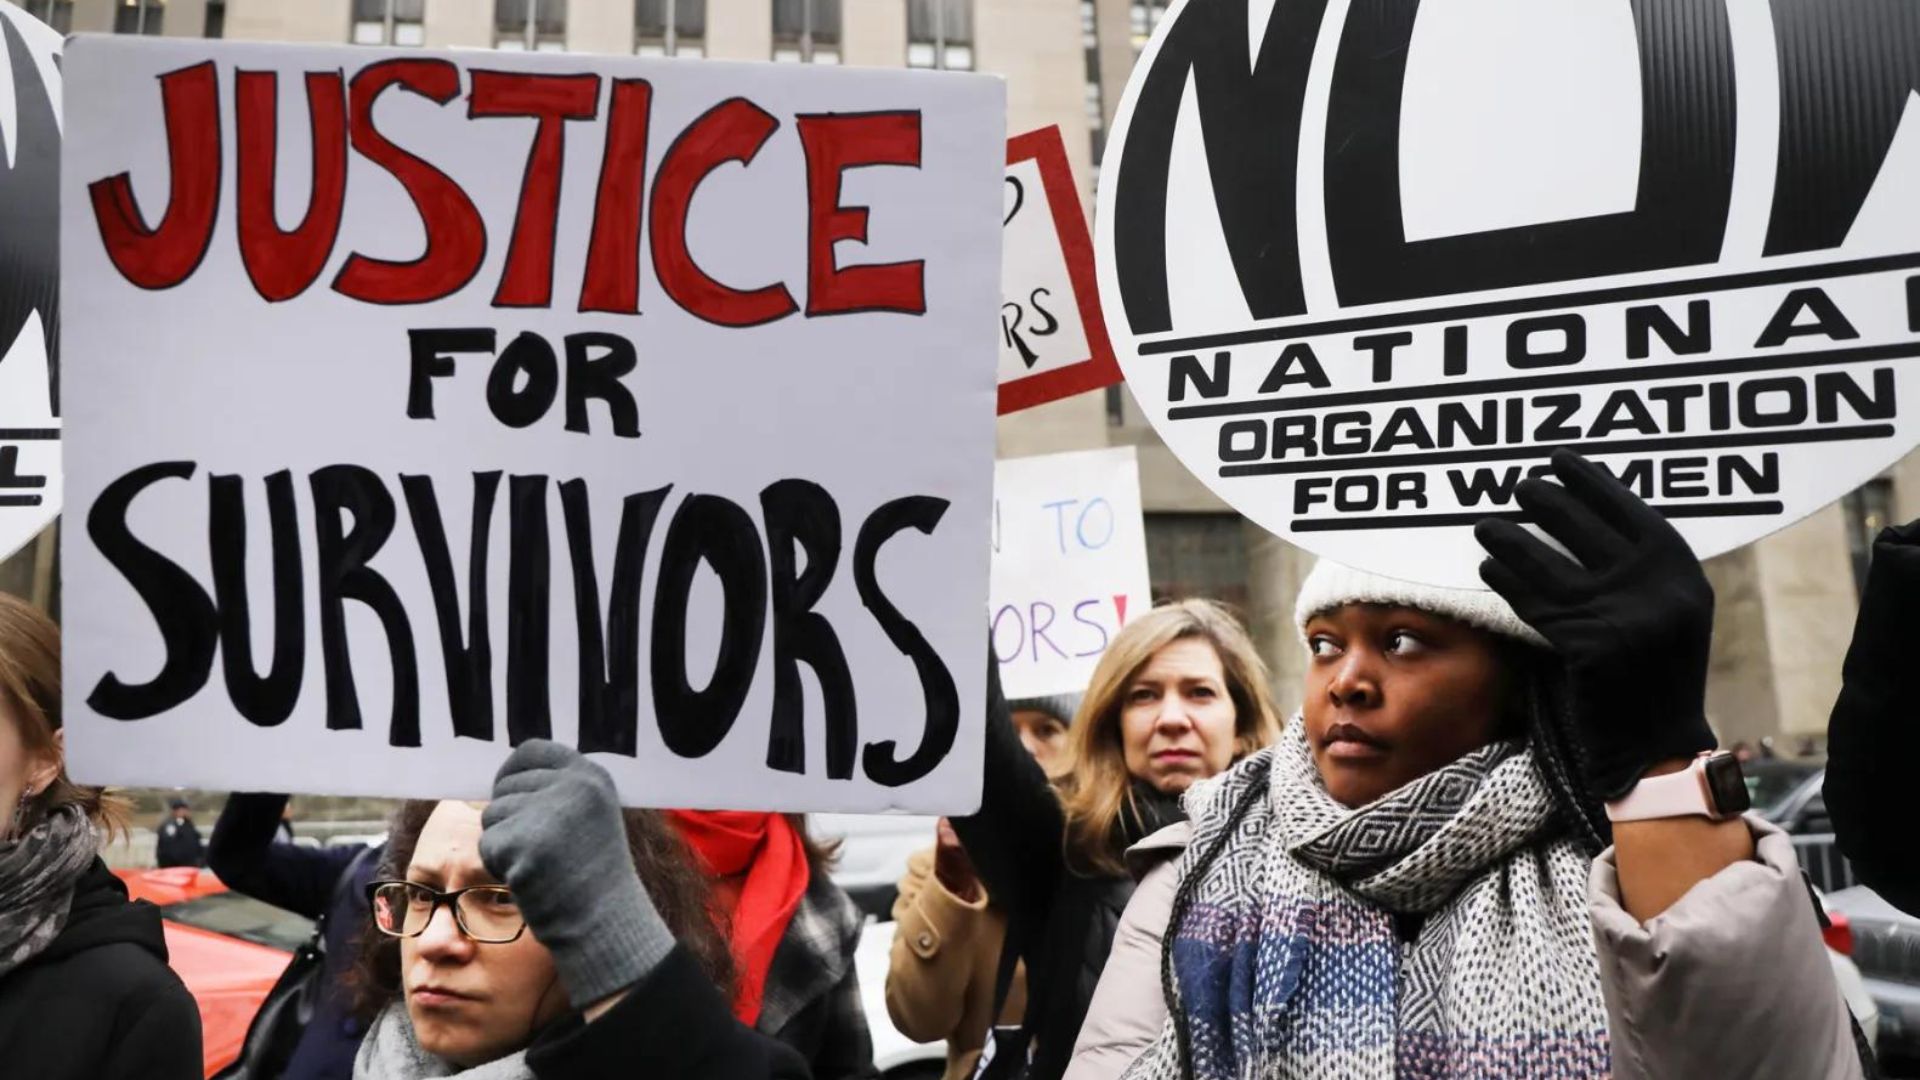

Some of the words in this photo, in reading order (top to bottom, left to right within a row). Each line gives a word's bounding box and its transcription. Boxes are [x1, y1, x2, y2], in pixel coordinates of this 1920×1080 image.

[88, 57, 926, 328] JUSTICE
[406, 328, 641, 438] FOR
[1218, 367, 1896, 463] ORGANIZATION
[1041, 497, 1115, 555] TO
[1292, 471, 1427, 515] FOR
[1446, 452, 1780, 506] WMEN
[86, 460, 959, 787] SURVIVORS
